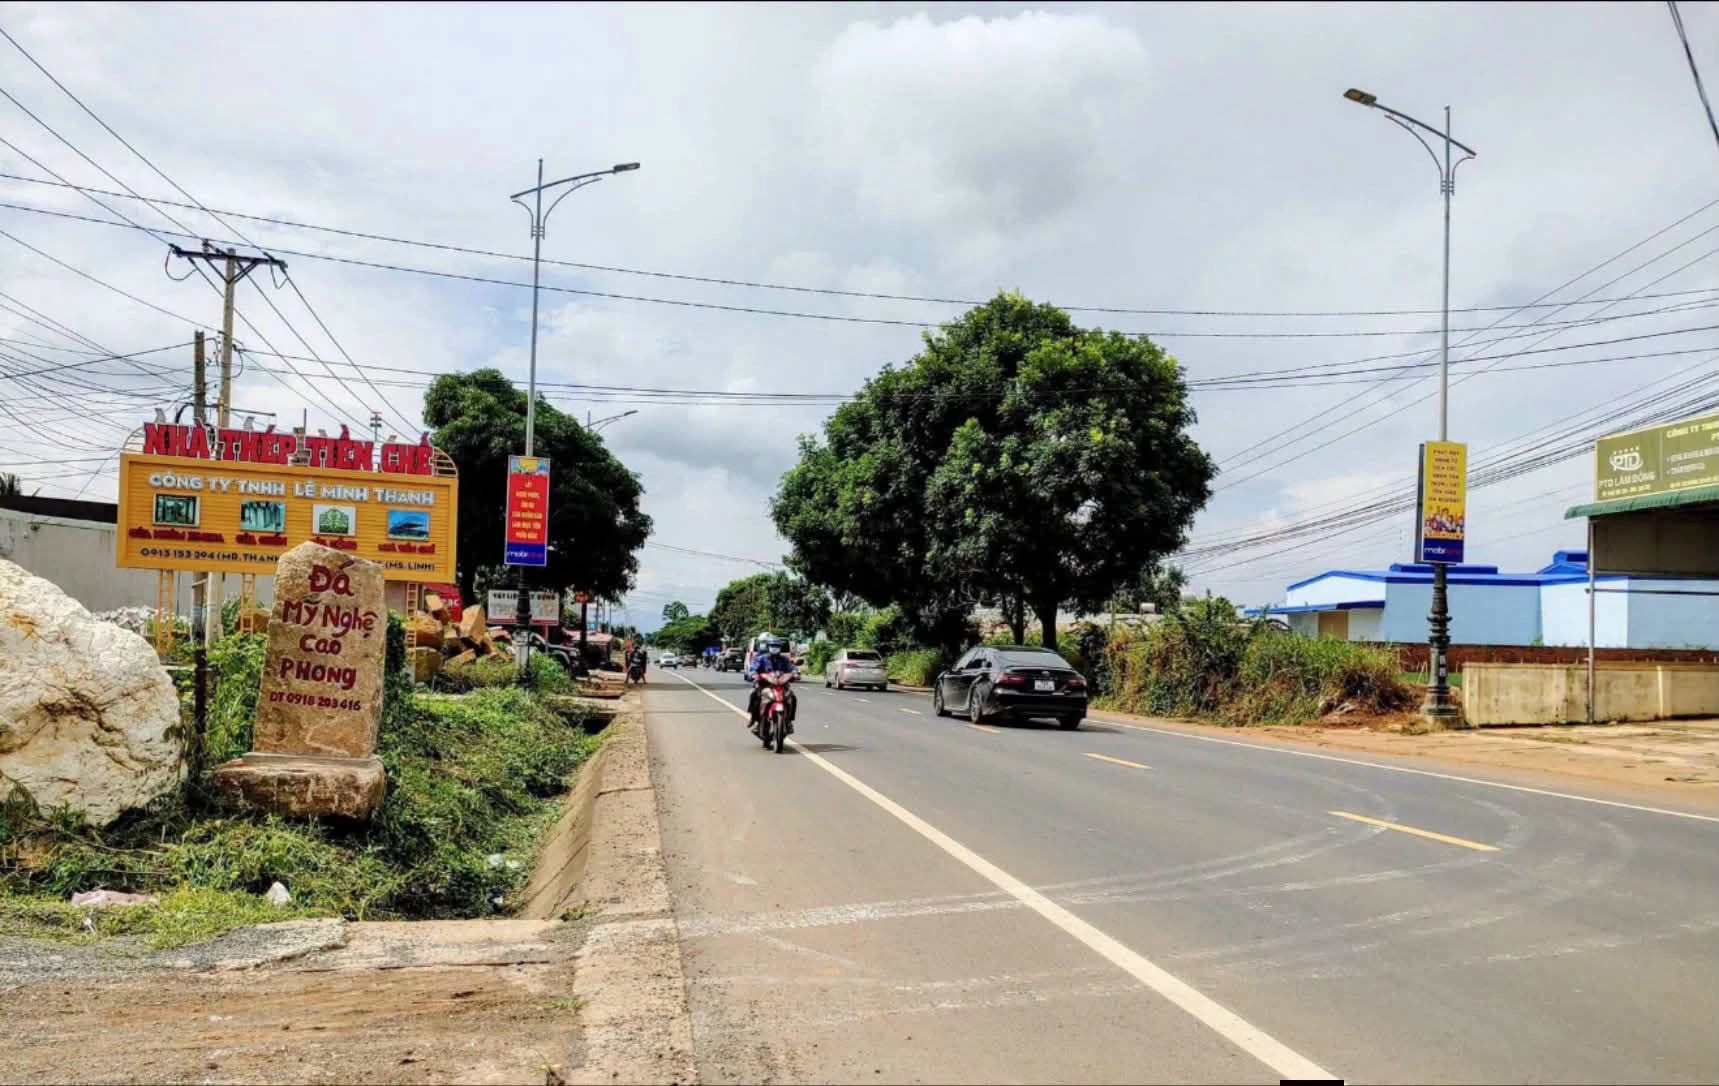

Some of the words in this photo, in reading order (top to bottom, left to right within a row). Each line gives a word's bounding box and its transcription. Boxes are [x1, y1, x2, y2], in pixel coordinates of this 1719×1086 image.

[144, 417, 211, 459] NHÀ
[217, 424, 297, 464] THÉP
[149, 470, 204, 489] CÔNG
[208, 477, 232, 493] TY
[238, 480, 286, 496] TNHH
[373, 487, 435, 506] THANH
[308, 560, 355, 597] Đá
[322, 604, 378, 639] Nghệ
[300, 634, 342, 656] Cao
[287, 692, 315, 706] 0918
[340, 698, 361, 711] 416
